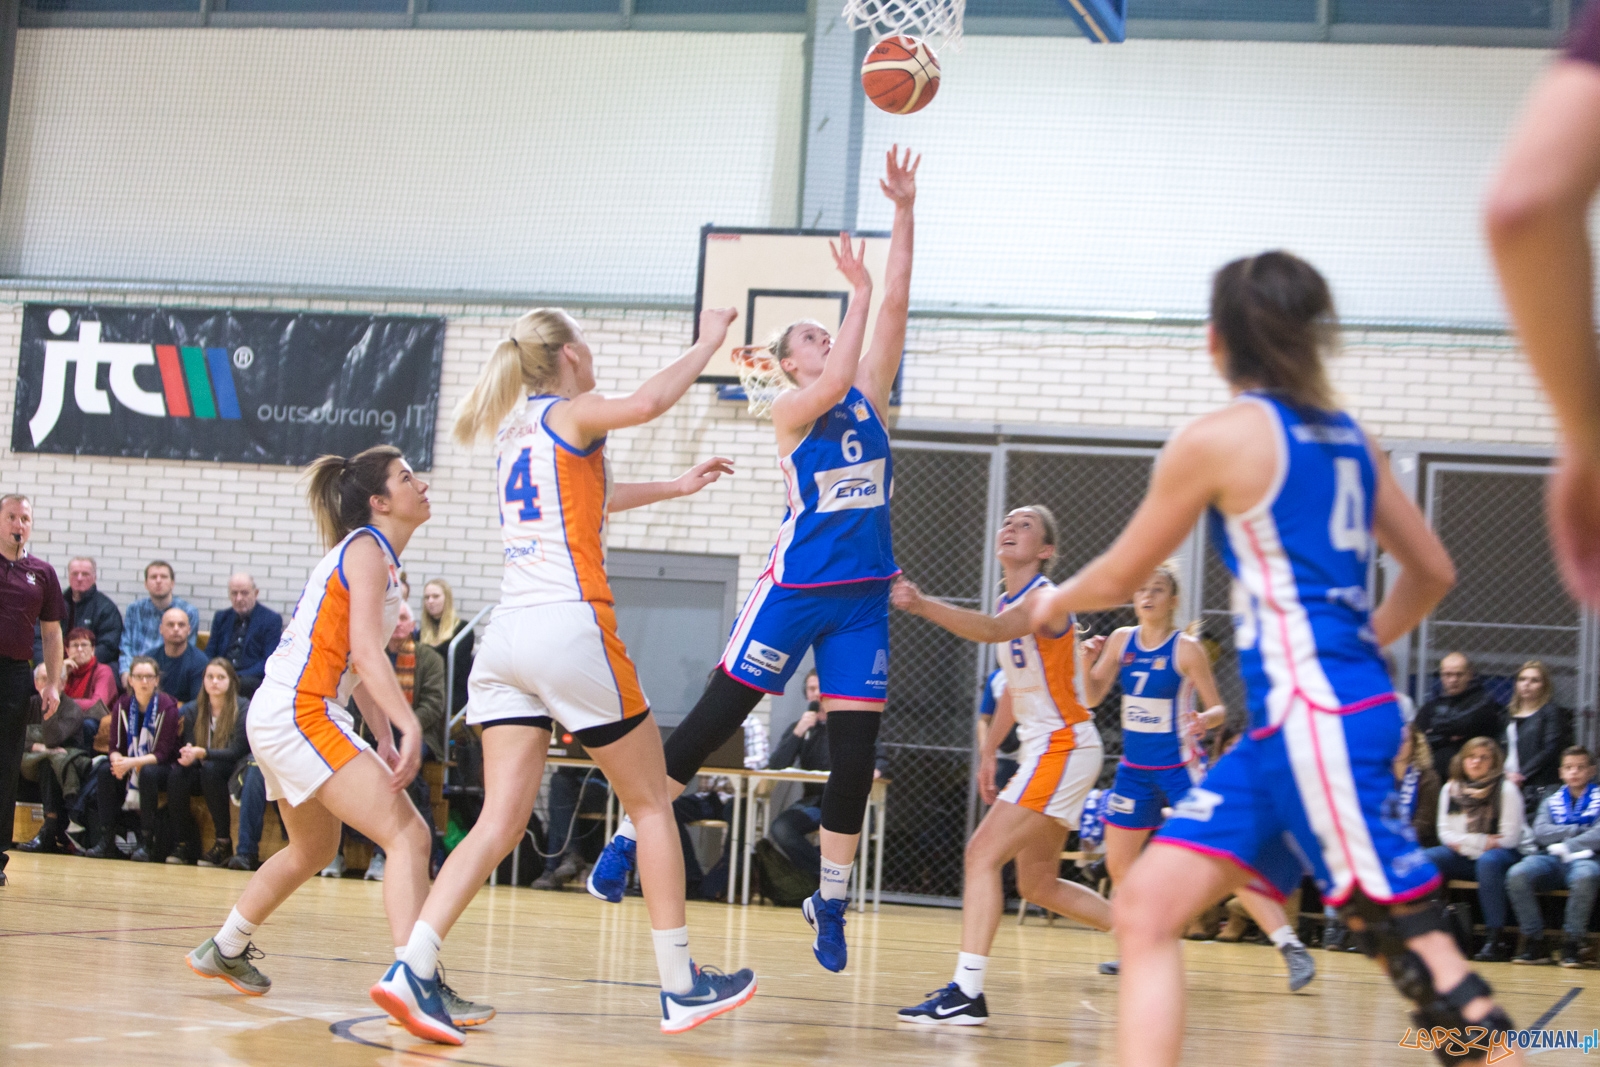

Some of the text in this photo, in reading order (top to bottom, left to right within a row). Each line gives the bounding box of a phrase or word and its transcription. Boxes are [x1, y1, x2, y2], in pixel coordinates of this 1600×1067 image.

[29, 309, 166, 448] jtc
[257, 403, 427, 435] outsourcing IT
[841, 429, 863, 463] 6
[835, 484, 877, 499] Enea
[1328, 456, 1369, 562] 4
[1009, 638, 1027, 669] 6
[1130, 670, 1151, 696] 7
